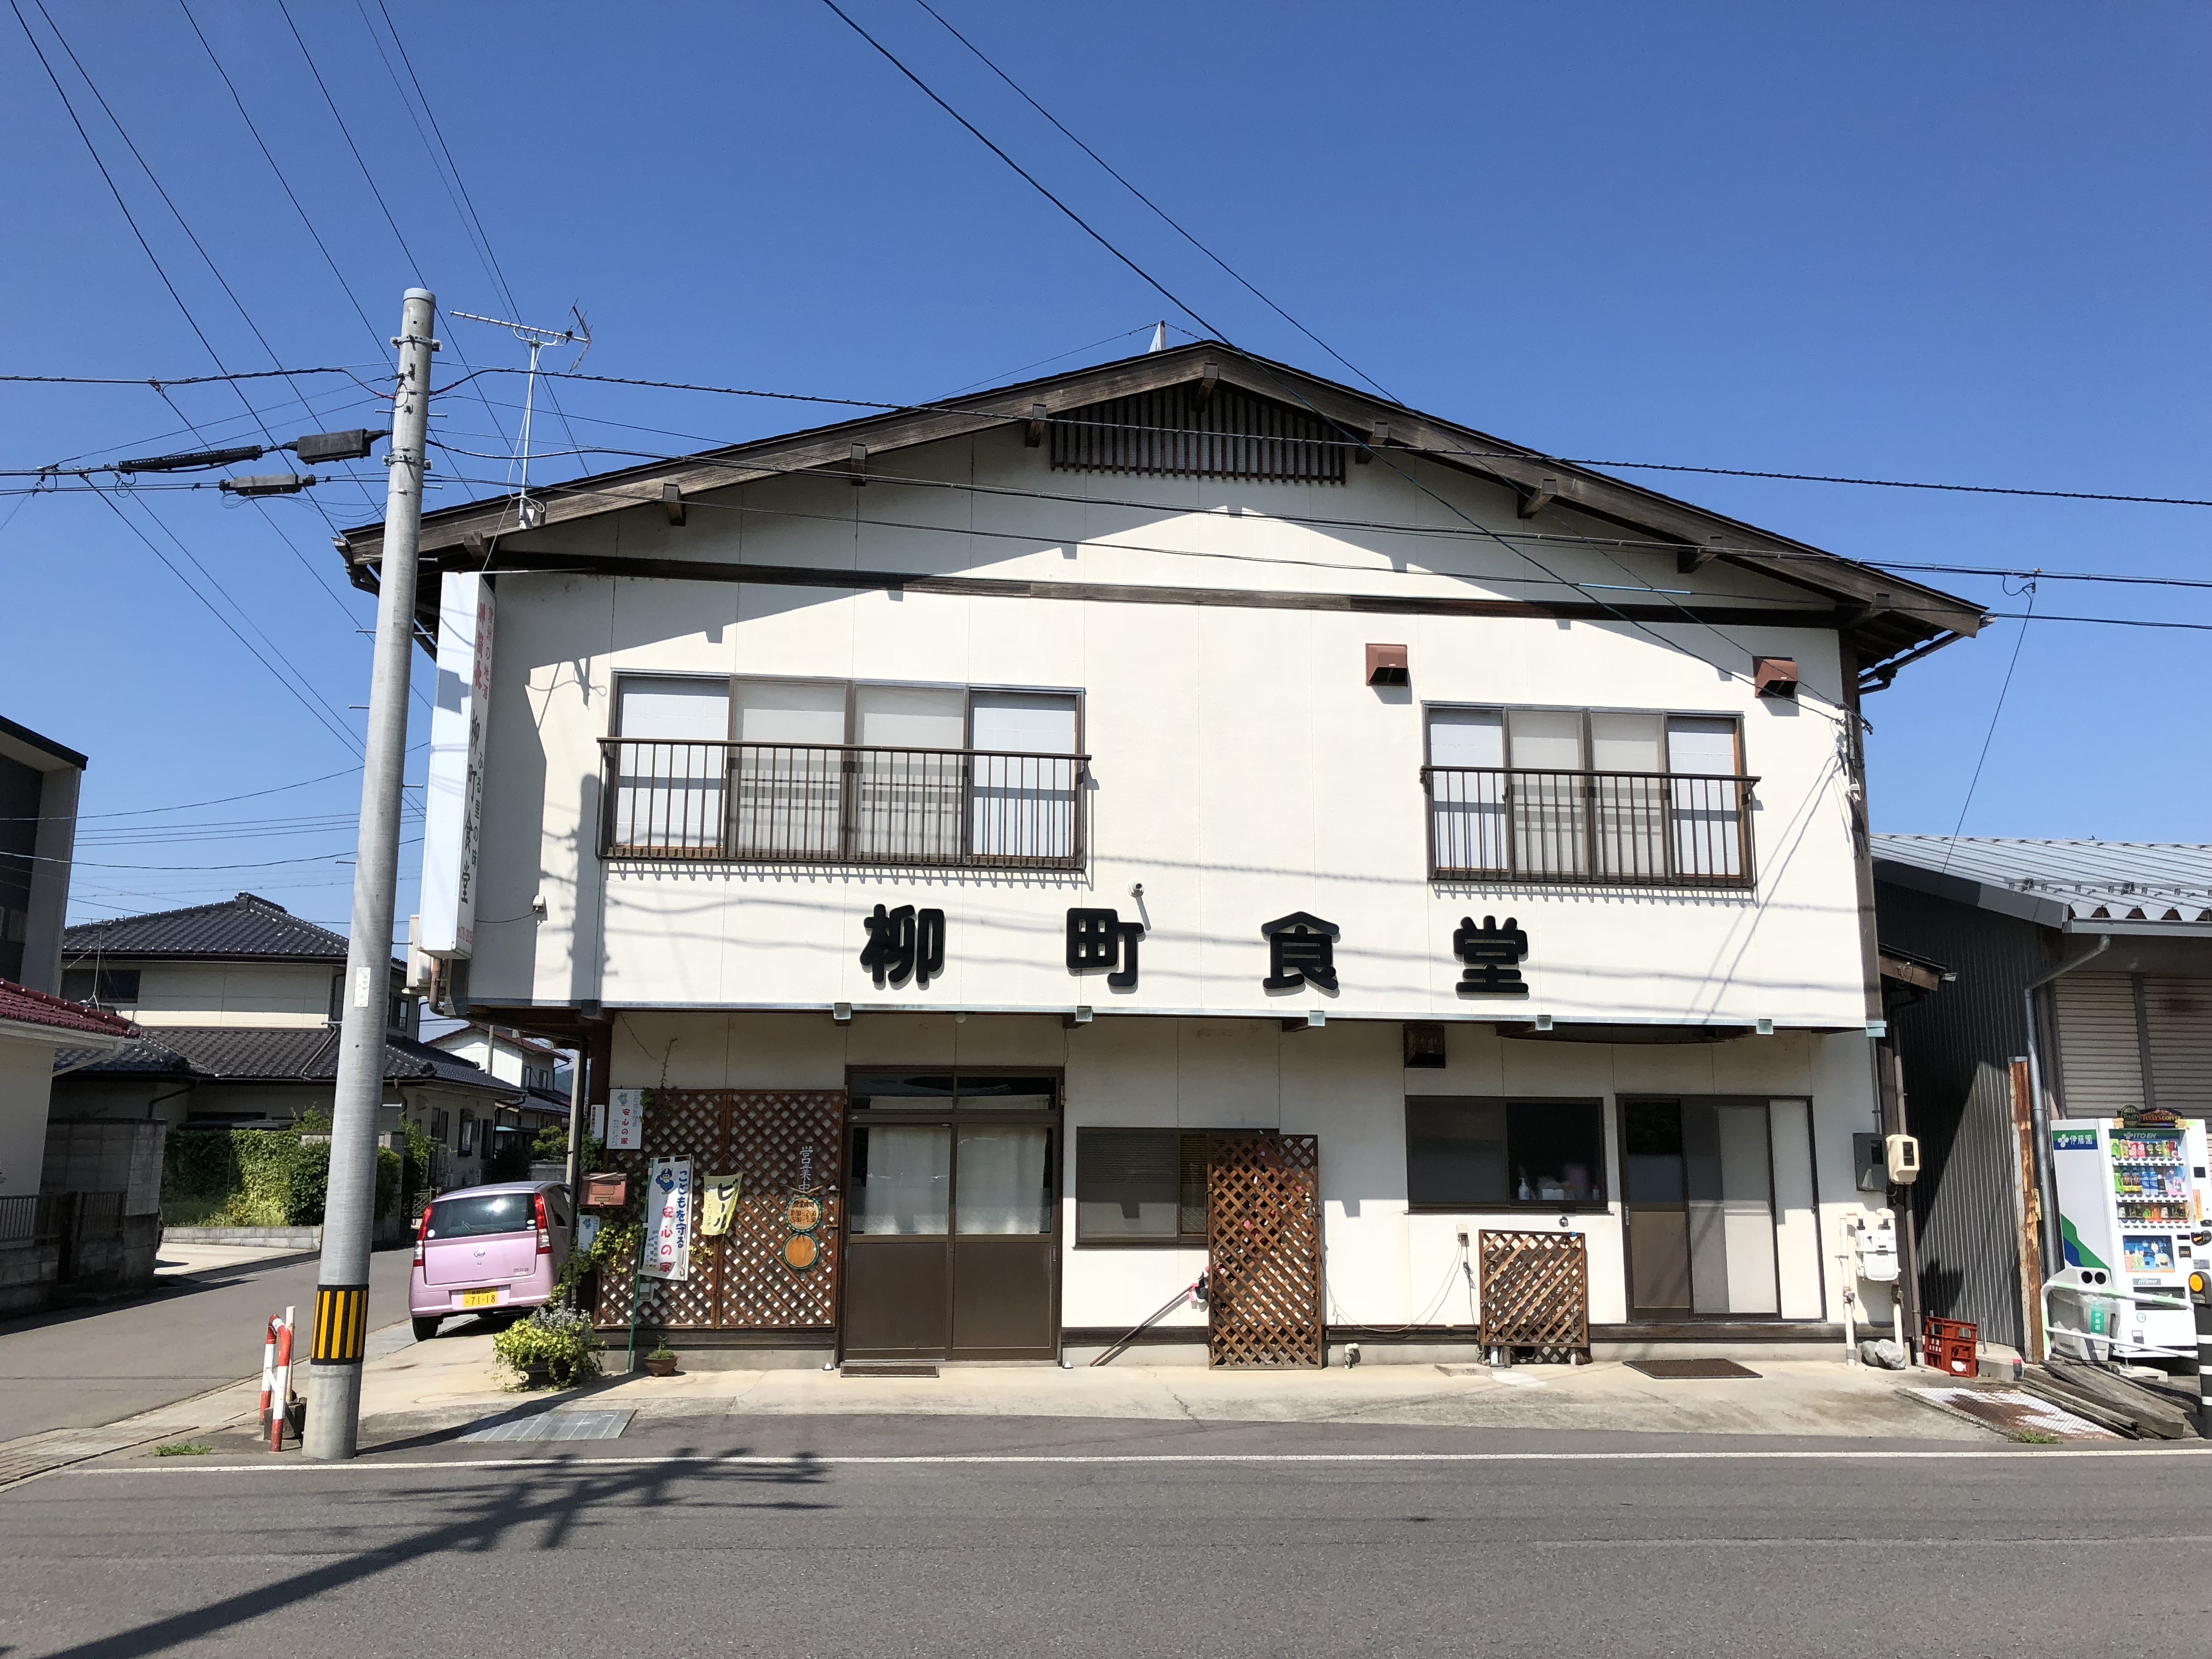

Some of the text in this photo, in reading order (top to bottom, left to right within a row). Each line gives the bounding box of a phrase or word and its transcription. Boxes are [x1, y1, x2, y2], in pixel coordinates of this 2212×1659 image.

[461, 709, 481, 904] 柳町食堂
[471, 752, 483, 868] ふる里の味
[860, 904, 1530, 994] 柳町食堂
[620, 1108, 630, 1145] 安心の家
[2069, 1134, 2094, 1145] 伊藤園
[798, 1146, 814, 1193] 営業中
[675, 1170, 688, 1249] こどもを守る
[713, 1178, 738, 1230] ビール
[658, 1205, 674, 1273] 安心の家
[470, 1294, 496, 1306] 71-18
